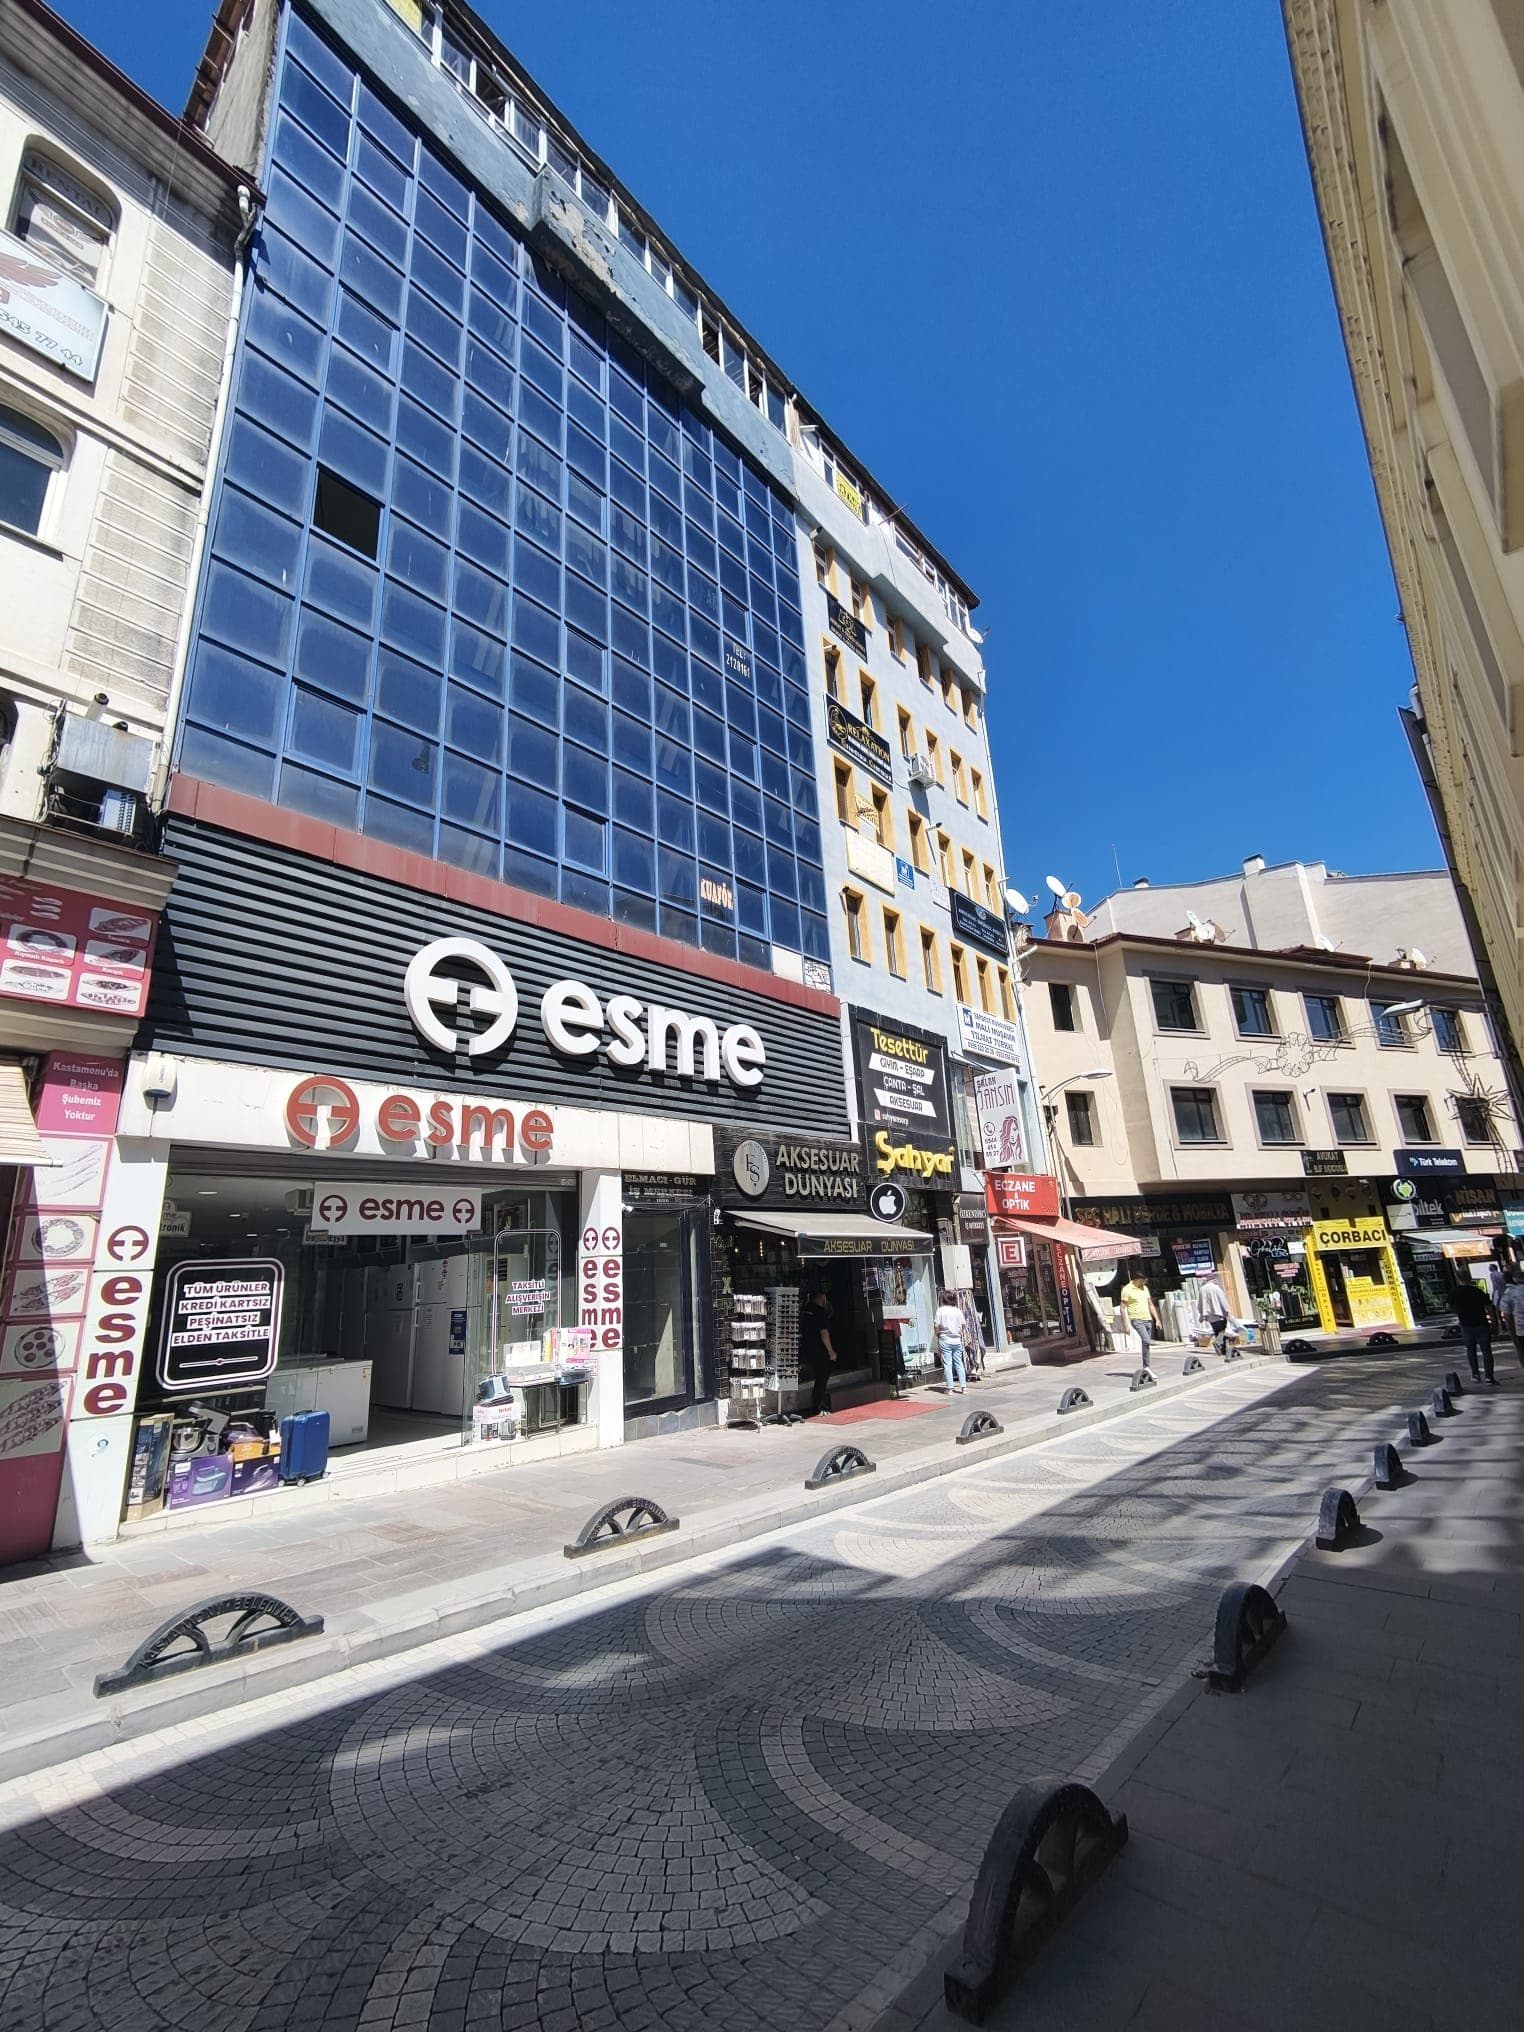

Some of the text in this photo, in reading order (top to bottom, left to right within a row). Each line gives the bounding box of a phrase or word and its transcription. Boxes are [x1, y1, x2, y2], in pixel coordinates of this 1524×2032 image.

[540, 979, 767, 1087] esme
[870, 1027, 929, 1065] Tesettür
[53, 1061, 119, 1078] Kastamonu'da
[69, 1078, 99, 1092] Başka
[883, 1076, 907, 1092] ÇANTA
[61, 1093, 102, 1107] Şubemiz
[64, 1108, 96, 1121] Yoktur
[376, 1093, 555, 1151] esme
[776, 1144, 859, 1173] AKSESUAR
[994, 1179, 1036, 1193] ECZANE
[358, 1197, 445, 1222] esme
[1103, 1205, 1132, 1225] HALI
[1134, 1204, 1171, 1224] PERDE
[823, 1240, 873, 1254] AKSESUAR
[1319, 1229, 1387, 1248] ÇORBACI
[1055, 1243, 1067, 1288] ECZANE
[187, 1280, 268, 1295] TÜM ÜRÜNLER
[180, 1297, 269, 1312] KREDİ KARTSIZ
[601, 1257, 622, 1349] esme
[189, 1313, 258, 1329] PEŞİNATSIZ
[173, 1326, 269, 1345] ELDEN TAKSİTLE
[83, 1275, 143, 1416] esme
